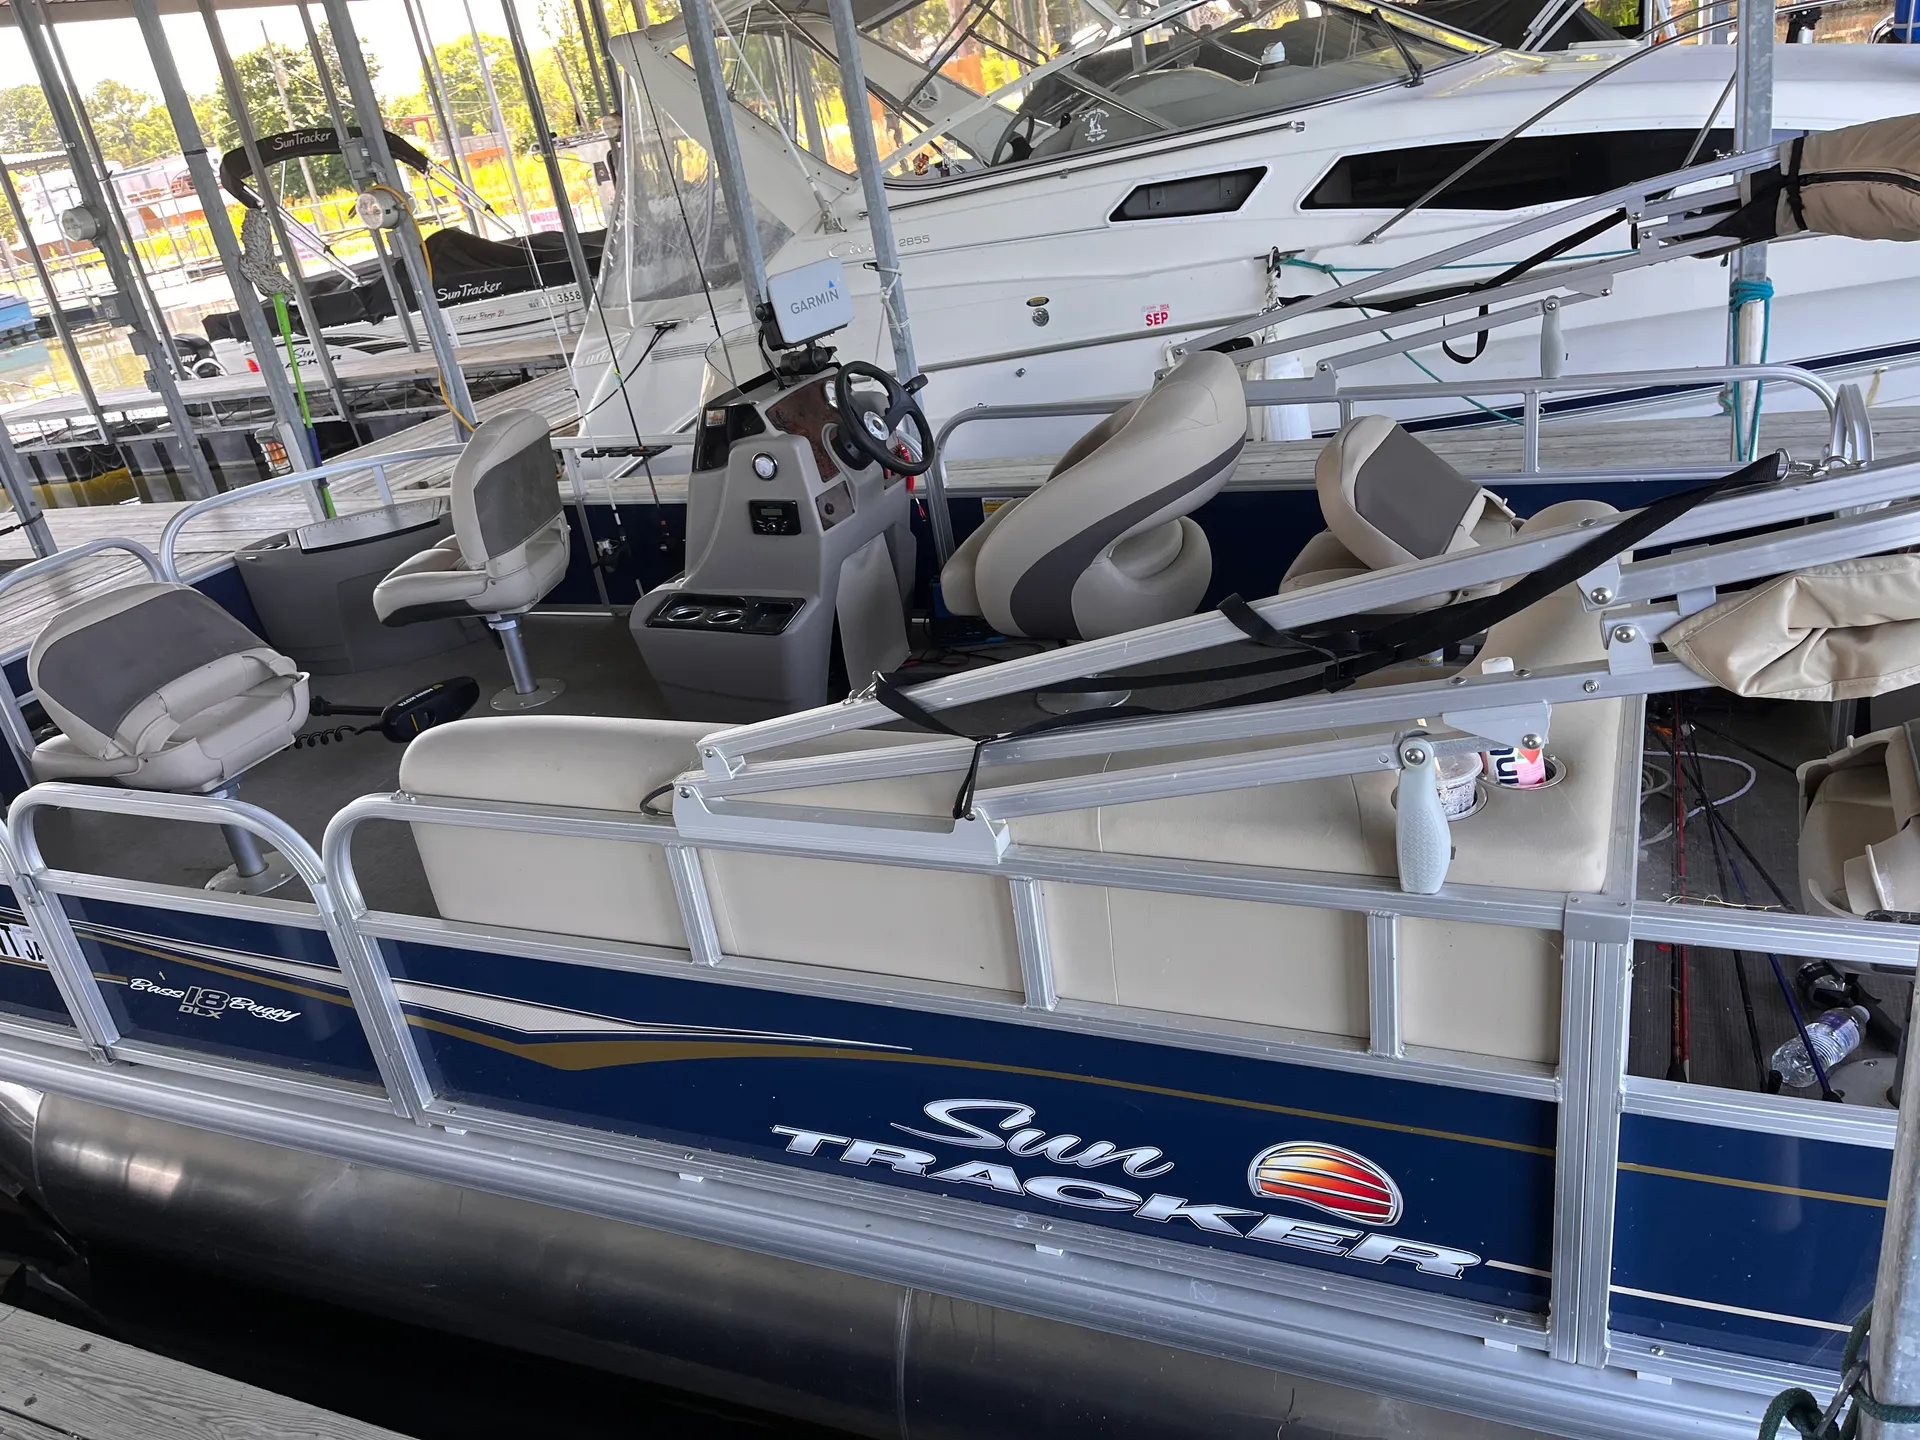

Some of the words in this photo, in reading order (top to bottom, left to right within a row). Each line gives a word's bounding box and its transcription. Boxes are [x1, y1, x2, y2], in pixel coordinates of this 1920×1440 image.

[272, 131, 331, 151] SunTracker
[898, 234, 931, 247] 2855
[437, 281, 502, 301] SunTracker
[790, 288, 840, 315] GARMIN
[1145, 311, 1169, 327] SEP
[130, 978, 185, 999] Bass
[182, 985, 231, 1010] 18
[229, 996, 301, 1023] Buggy
[178, 1004, 223, 1020] DLX
[890, 1098, 1175, 1178] Sun
[770, 1124, 1482, 1281] TRACKER
